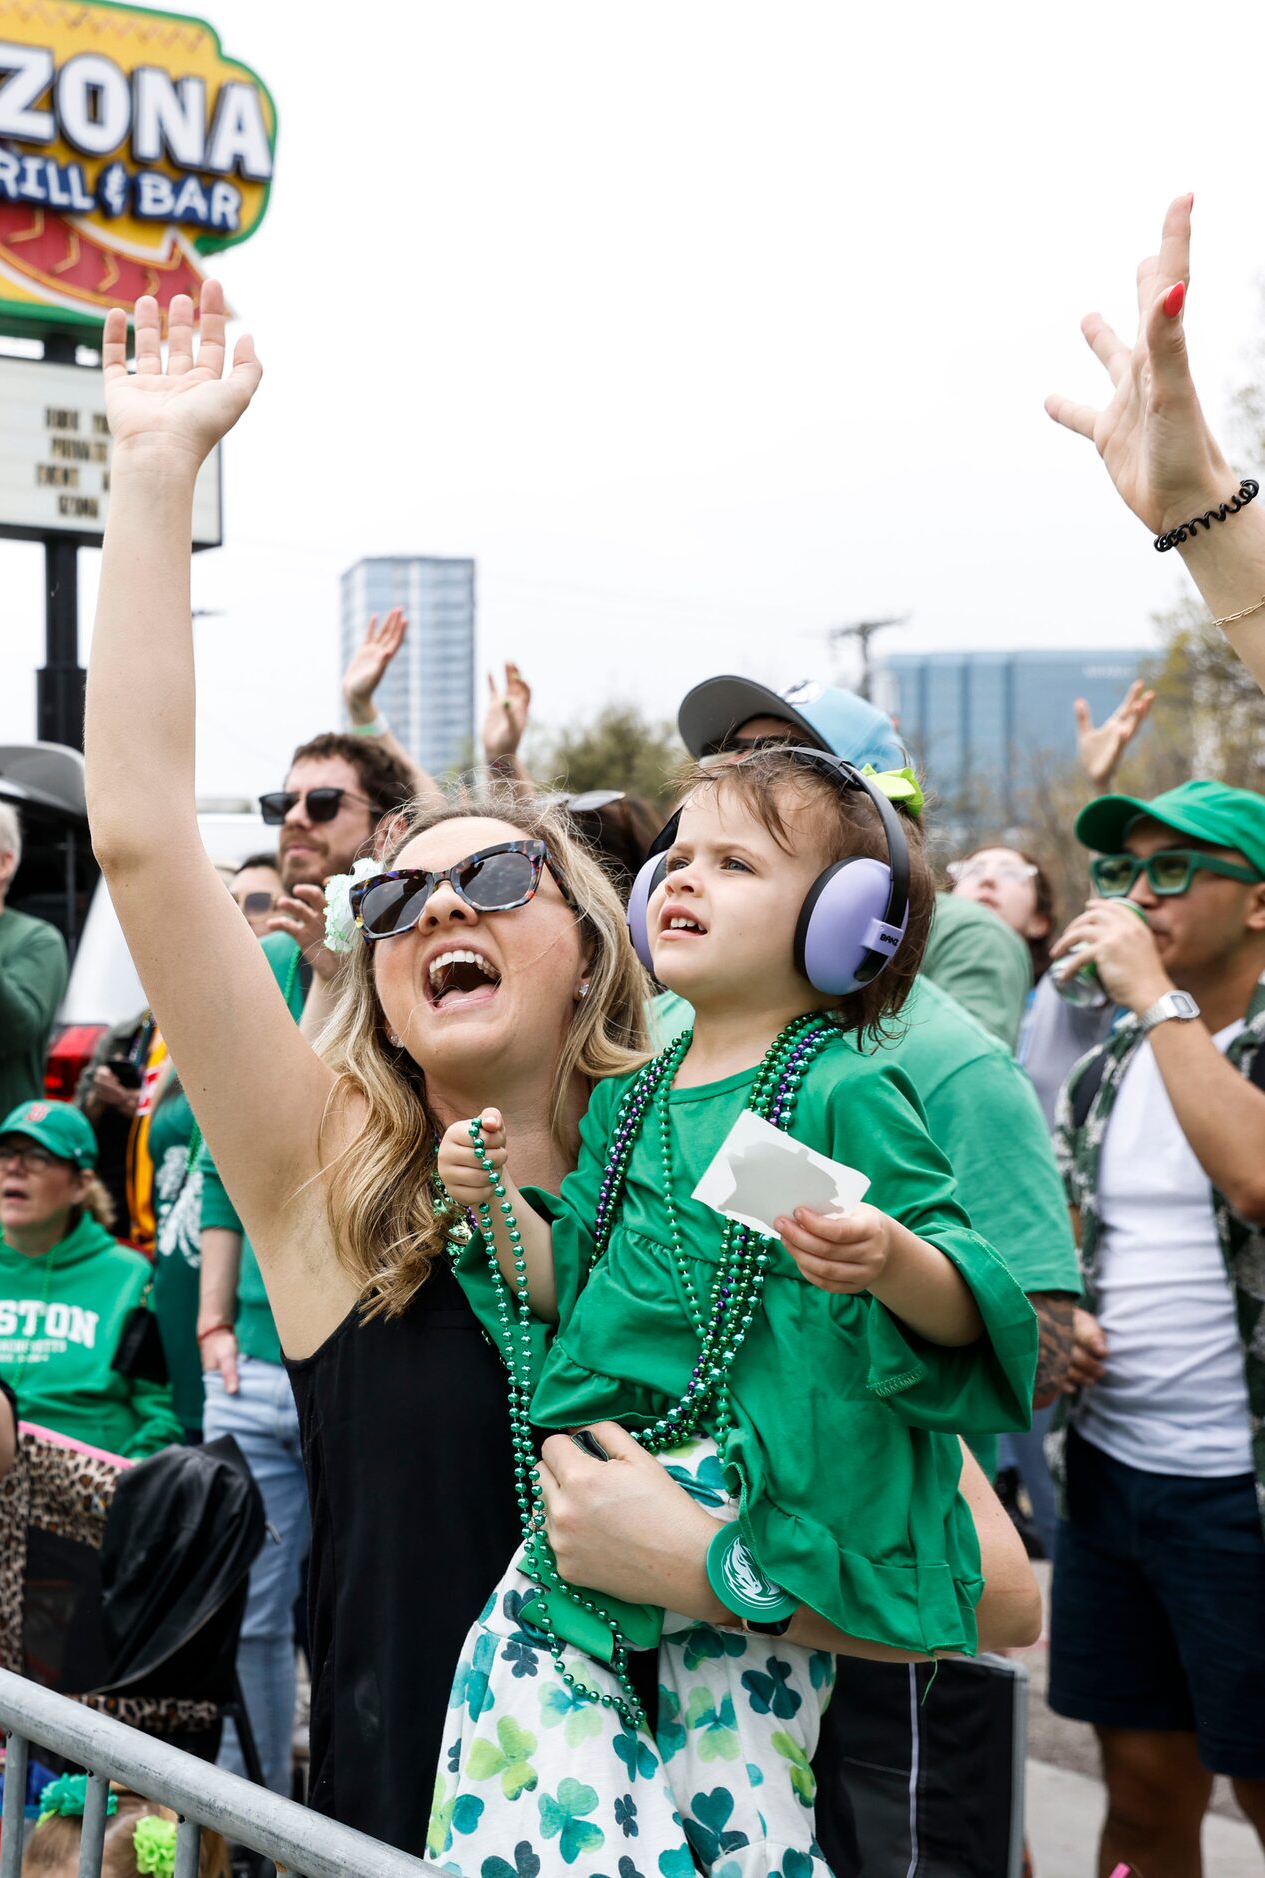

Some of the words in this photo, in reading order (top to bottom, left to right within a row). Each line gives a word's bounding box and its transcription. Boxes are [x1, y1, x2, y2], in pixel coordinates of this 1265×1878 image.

[101, 165, 128, 216] &
[138, 175, 241, 229] BAR
[880, 933, 900, 947] BANZ
